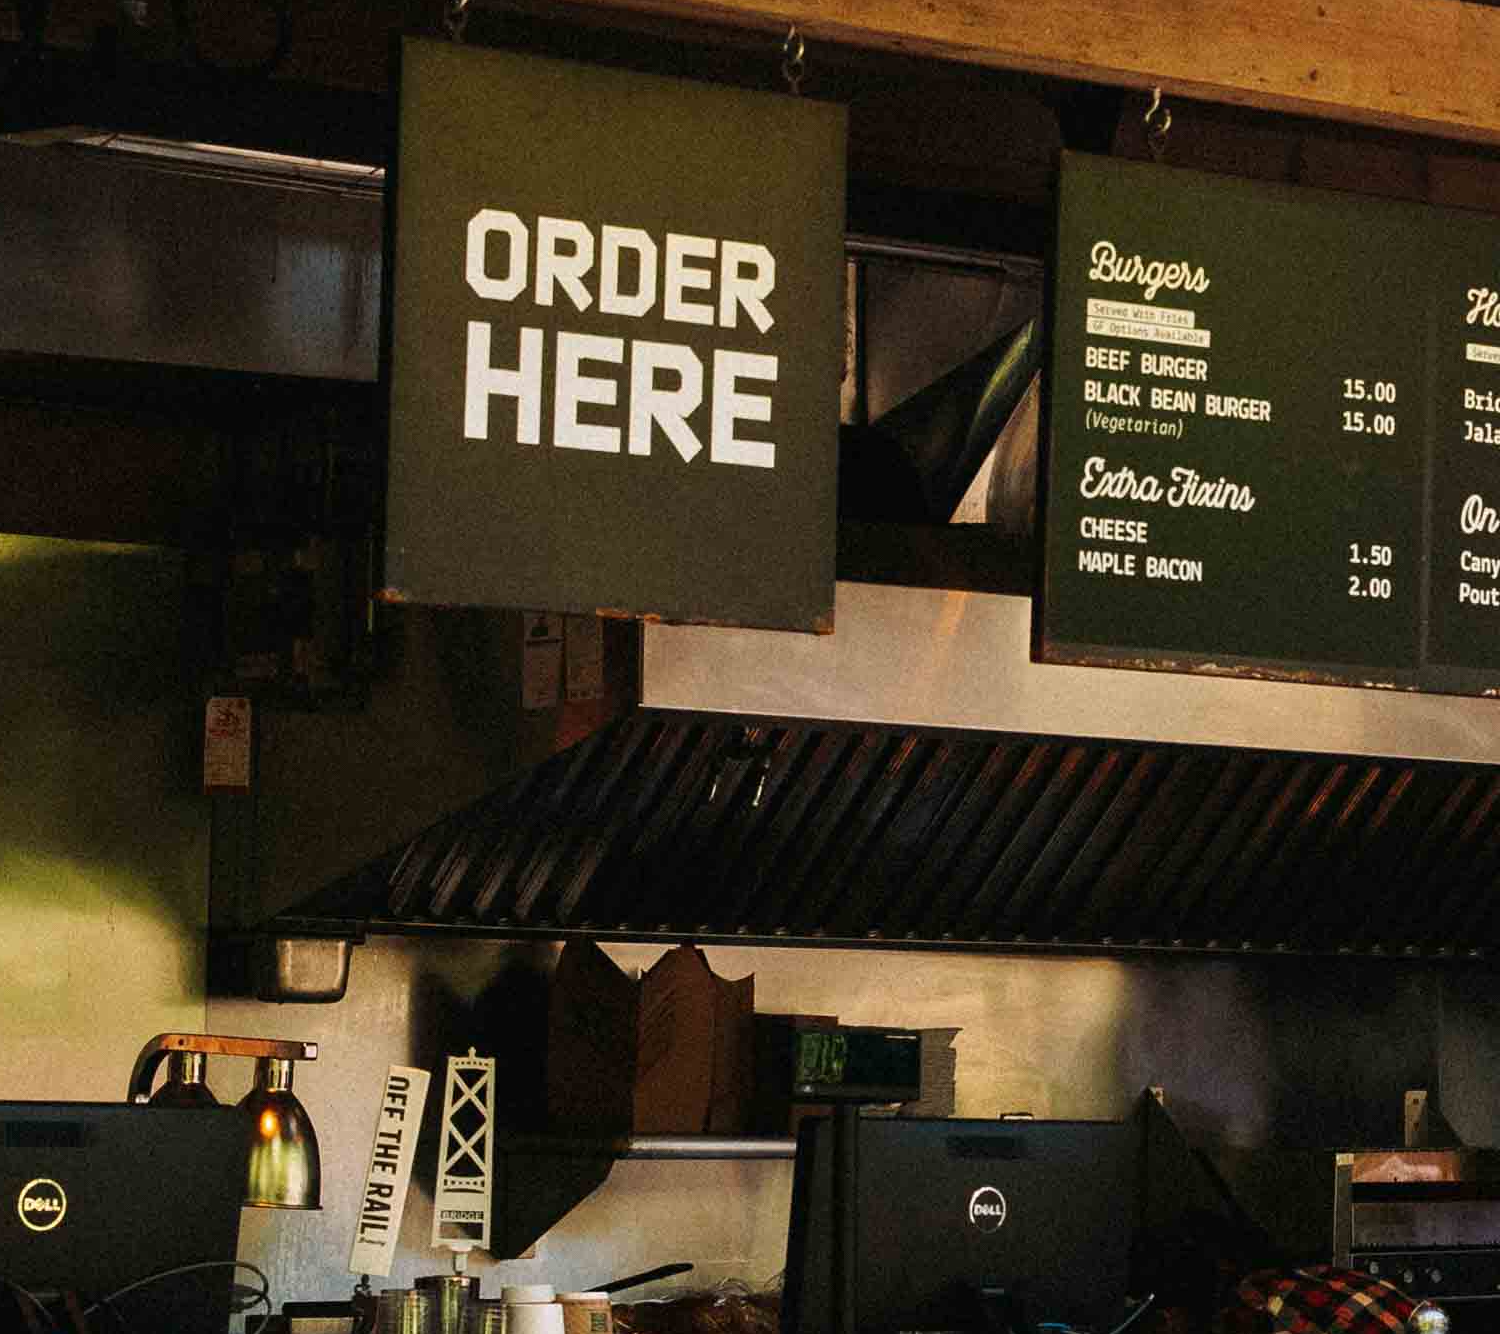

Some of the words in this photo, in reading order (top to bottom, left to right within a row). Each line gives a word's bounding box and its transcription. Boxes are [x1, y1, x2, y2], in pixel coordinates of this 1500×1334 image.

[465, 208, 775, 334] ORDER
[1089, 241, 1210, 300] Burgers
[464, 320, 778, 468] HERE
[1085, 346, 1130, 371] BEEF
[1141, 352, 1208, 381] BURGER
[1343, 378, 1396, 403] 15.00
[1084, 380, 1141, 406] BLACK
[1151, 388, 1196, 413] BEAN
[1205, 394, 1271, 421] BURGER
[1342, 411, 1395, 436] 15.00
[1085, 409, 1183, 439] (Vegetarian)
[1080, 456, 1163, 502] Extra
[1167, 467, 1255, 512] Fixins
[1460, 494, 1499, 534] On
[1080, 517, 1148, 543] CHEESE
[1349, 543, 1392, 566] 1.50
[1078, 550, 1135, 576] MAPLE
[1146, 556, 1202, 582] BACON
[1349, 576, 1391, 598] 2.00
[384, 1075, 410, 1122] OFF
[371, 1129, 402, 1175] THE
[24, 1197, 61, 1212] DELL
[973, 1204, 1002, 1216] DELL
